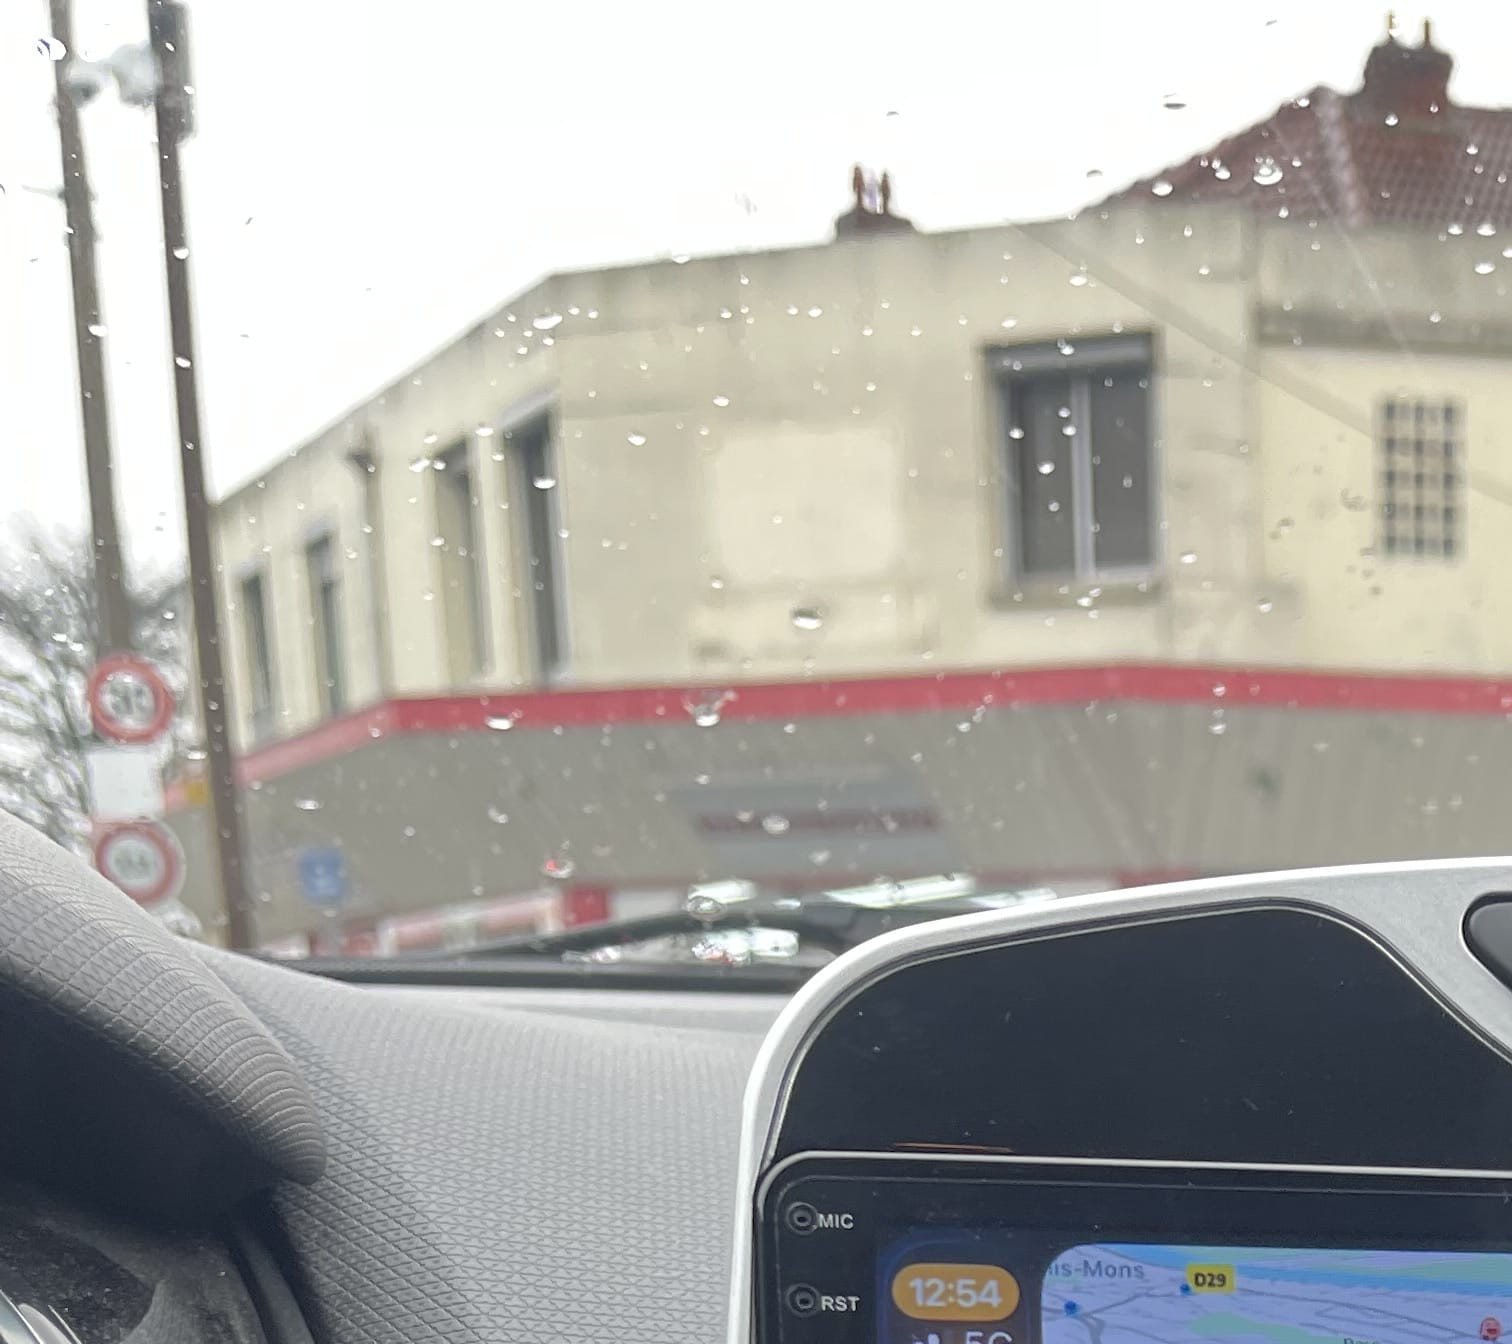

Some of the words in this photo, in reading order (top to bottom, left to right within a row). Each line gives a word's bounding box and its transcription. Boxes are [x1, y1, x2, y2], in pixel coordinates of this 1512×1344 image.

[817, 1214, 854, 1229] MIC
[1049, 1259, 1145, 1279] is-Mons
[1194, 1272, 1227, 1288] D29
[910, 1278, 1003, 1308] 12:54
[821, 1297, 859, 1312] RST
